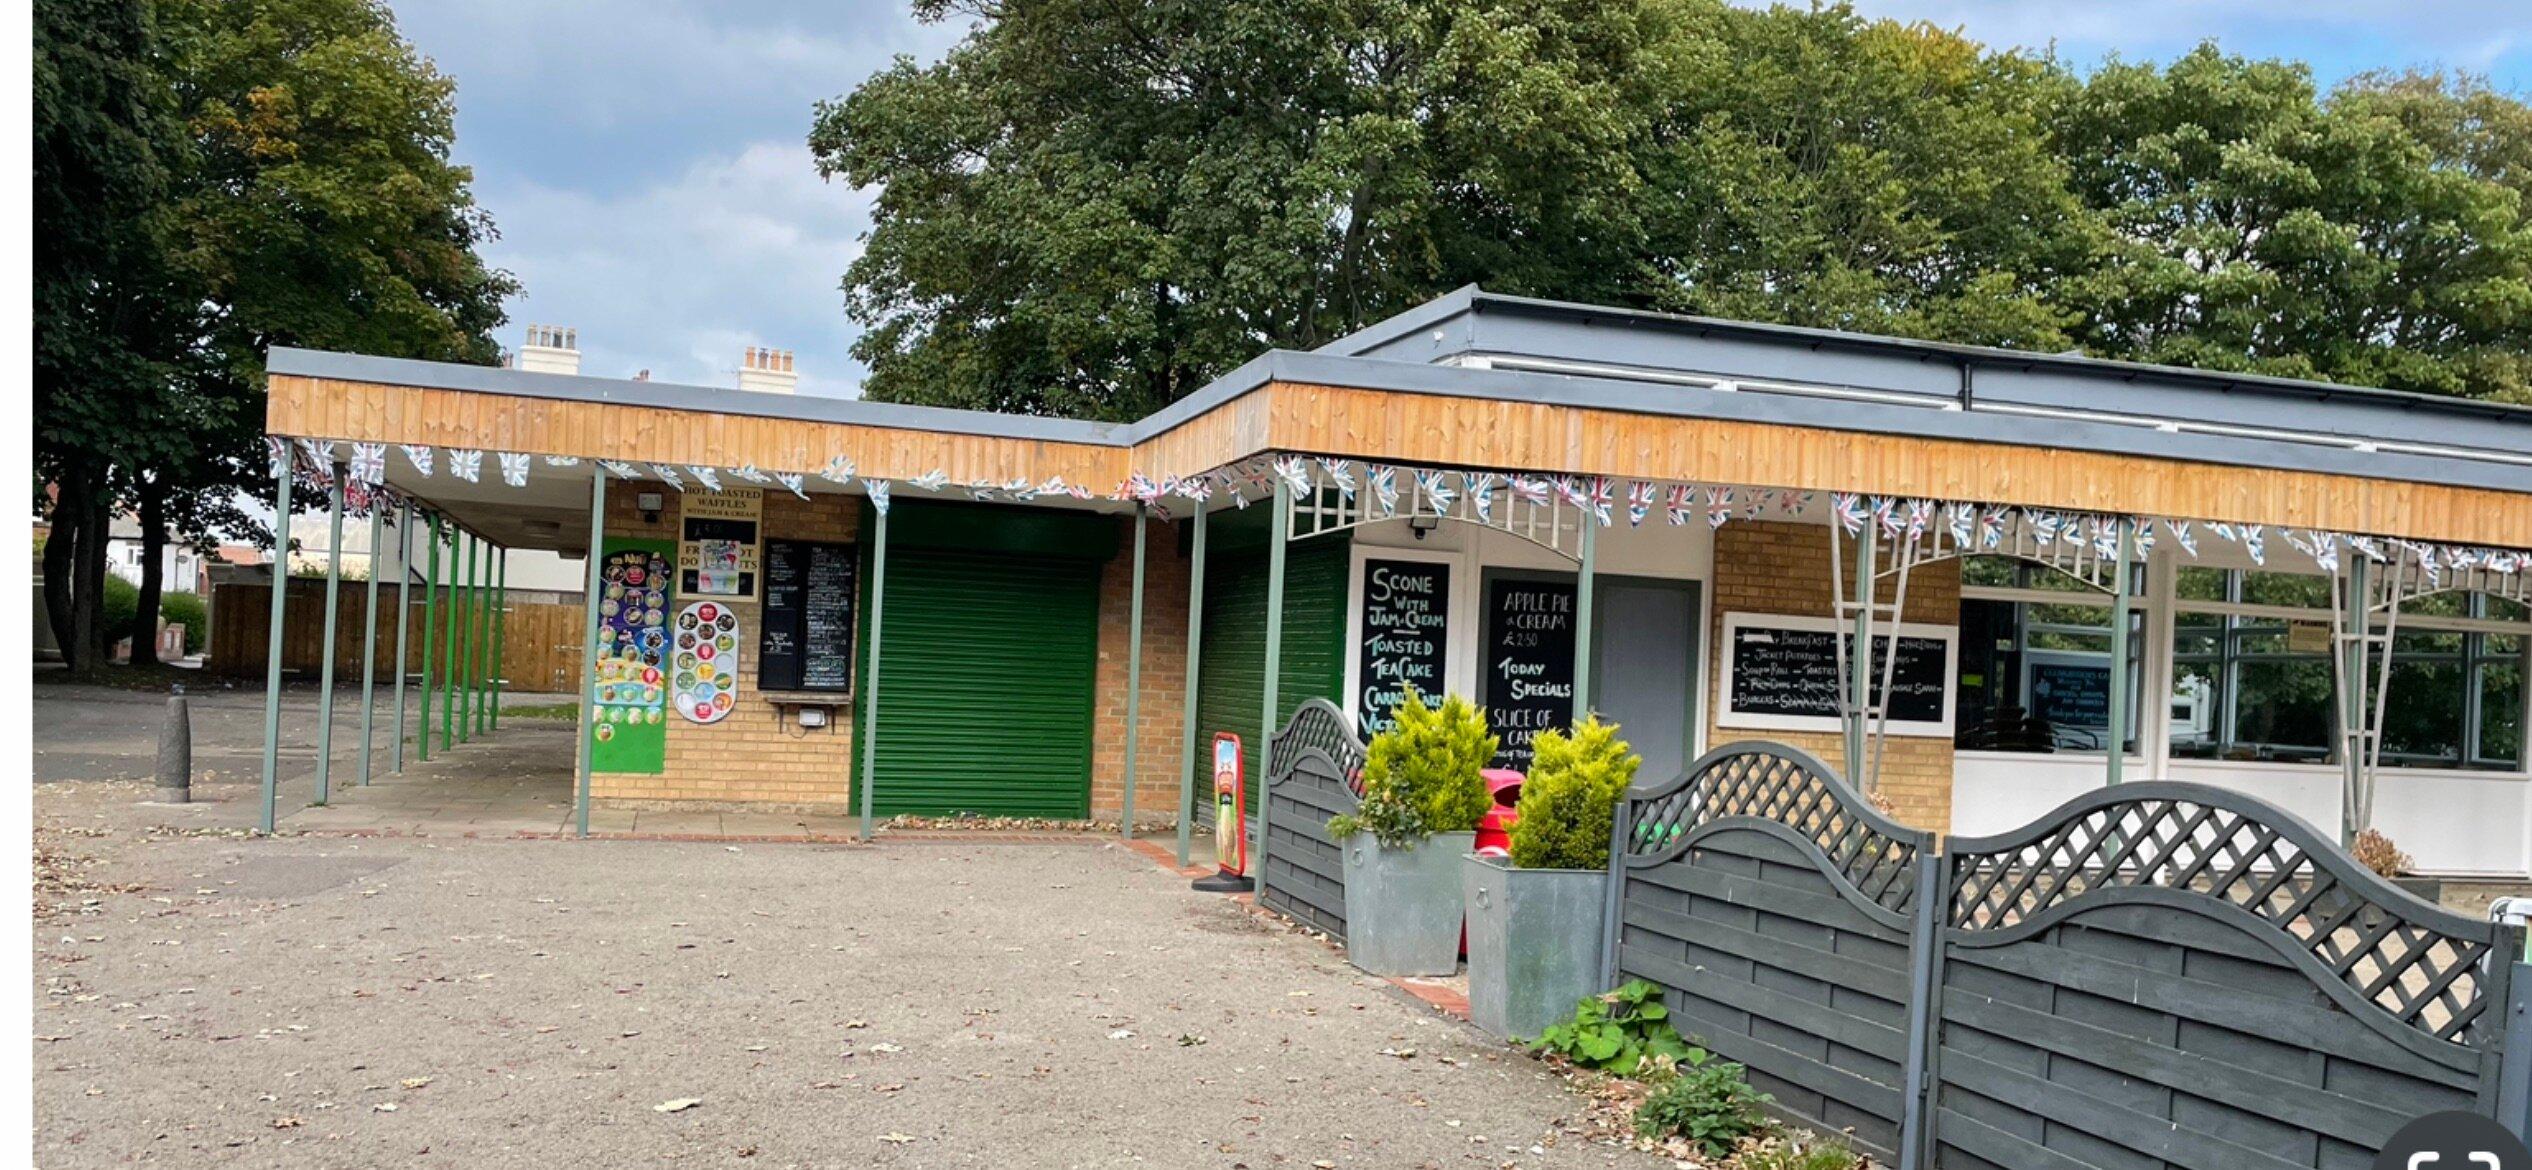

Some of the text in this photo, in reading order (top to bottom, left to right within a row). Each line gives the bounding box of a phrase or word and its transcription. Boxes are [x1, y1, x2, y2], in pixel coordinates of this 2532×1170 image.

[684, 486, 761, 499] HOT TOASTED
[698, 498, 747, 509] WAFFLES
[1371, 567, 1434, 602] SCONE
[1394, 595, 1430, 612] WITH
[1503, 592, 1571, 613] APPLE PIE
[1368, 606, 1399, 627] JAM
[1405, 610, 1444, 629] CREAM
[1517, 614, 1566, 630] CREAM
[1364, 633, 1434, 657] TOASTED
[1781, 630, 1828, 648] BREAKFAST
[1754, 648, 1822, 662] JACKET POTATOES
[1498, 656, 1546, 680] TODAY
[1364, 686, 1405, 712] CARRO
[1510, 679, 1571, 700] SPECIALS
[1358, 712, 1397, 734] VICTO
[1493, 708, 1552, 728] SLICE OF
